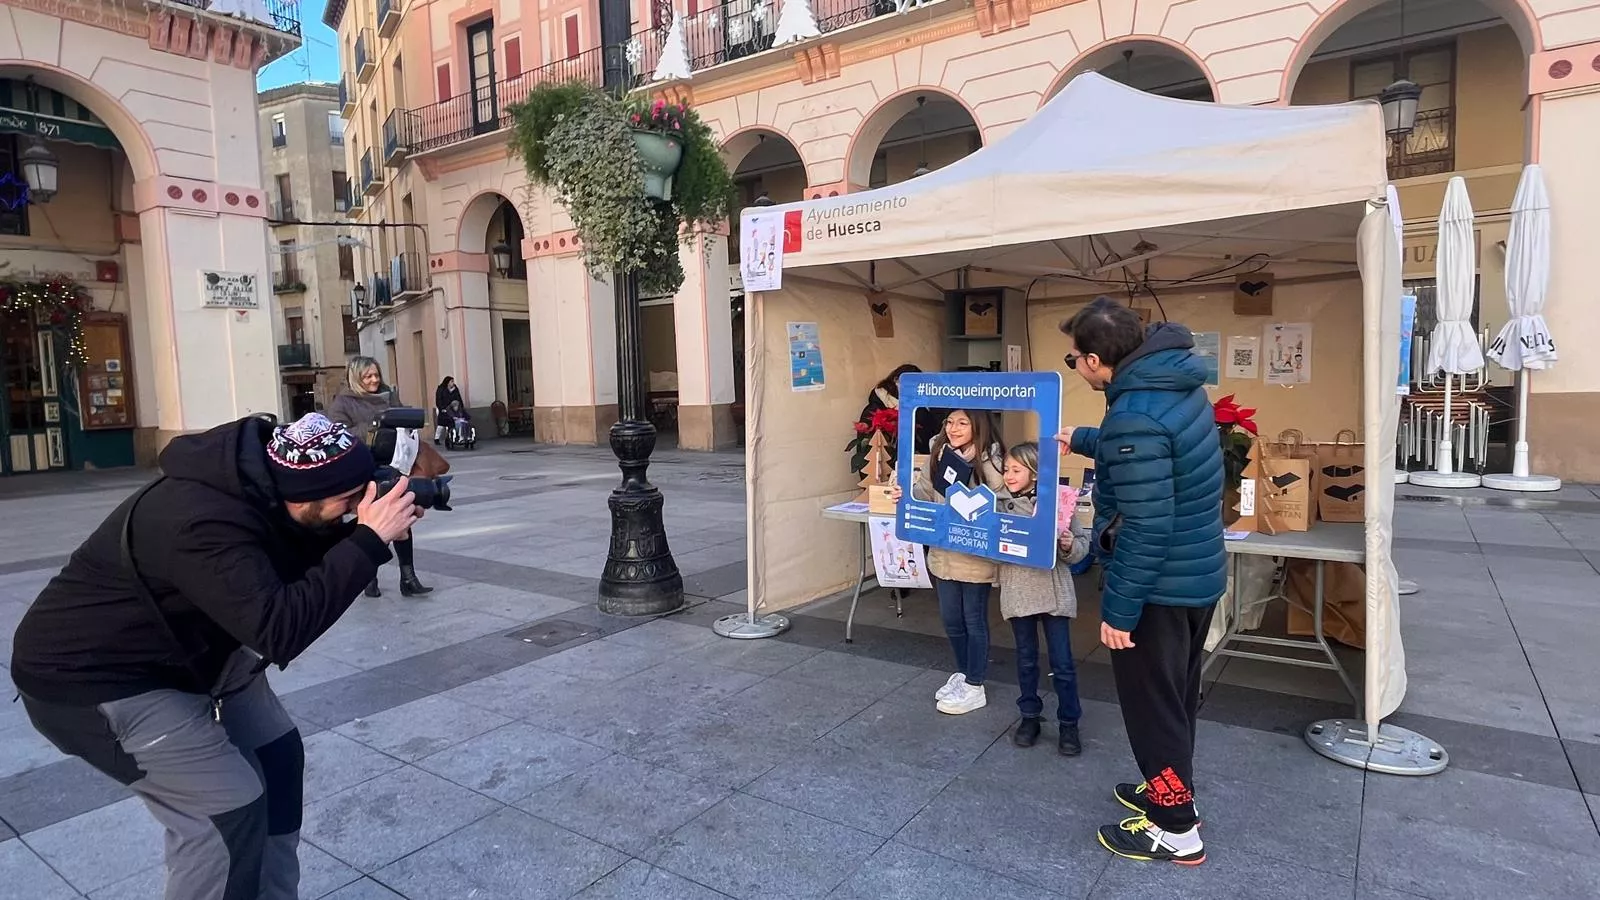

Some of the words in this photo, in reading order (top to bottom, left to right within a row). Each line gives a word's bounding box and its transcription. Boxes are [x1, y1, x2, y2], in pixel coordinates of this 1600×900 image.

[807, 195, 907, 224] Ayuntamiento
[806, 226, 823, 241] de
[828, 219, 881, 238] Huesca
[917, 383, 1036, 401] #librosqueimportan
[948, 526, 970, 538] LIBROS
[974, 530, 988, 540] QUE
[948, 534, 989, 550] IMPORTAN
